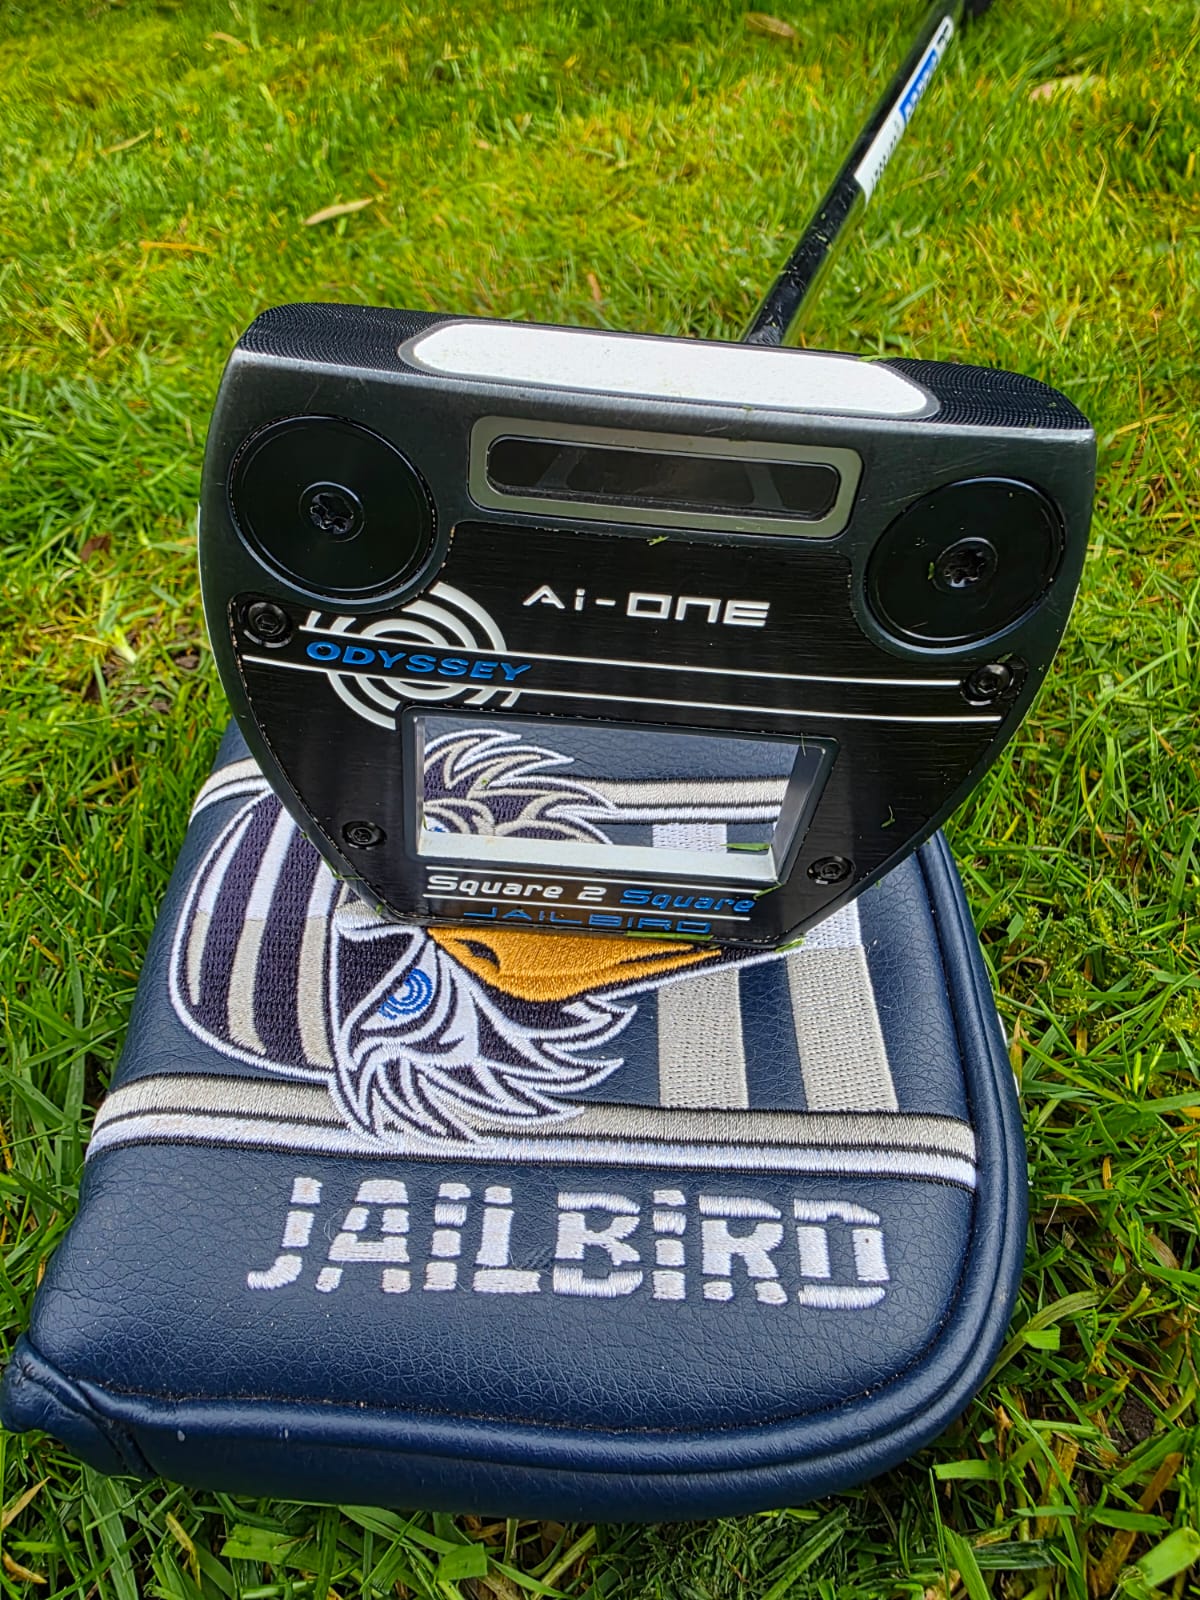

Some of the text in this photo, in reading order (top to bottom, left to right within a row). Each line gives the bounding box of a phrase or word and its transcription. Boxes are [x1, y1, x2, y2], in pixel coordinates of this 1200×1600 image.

[305, 640, 532, 681] ODYSSEY
[426, 874, 756, 914] Square 2 Square
[463, 906, 713, 934] JAILBIRD
[246, 1175, 891, 1310] JAILBIRD
